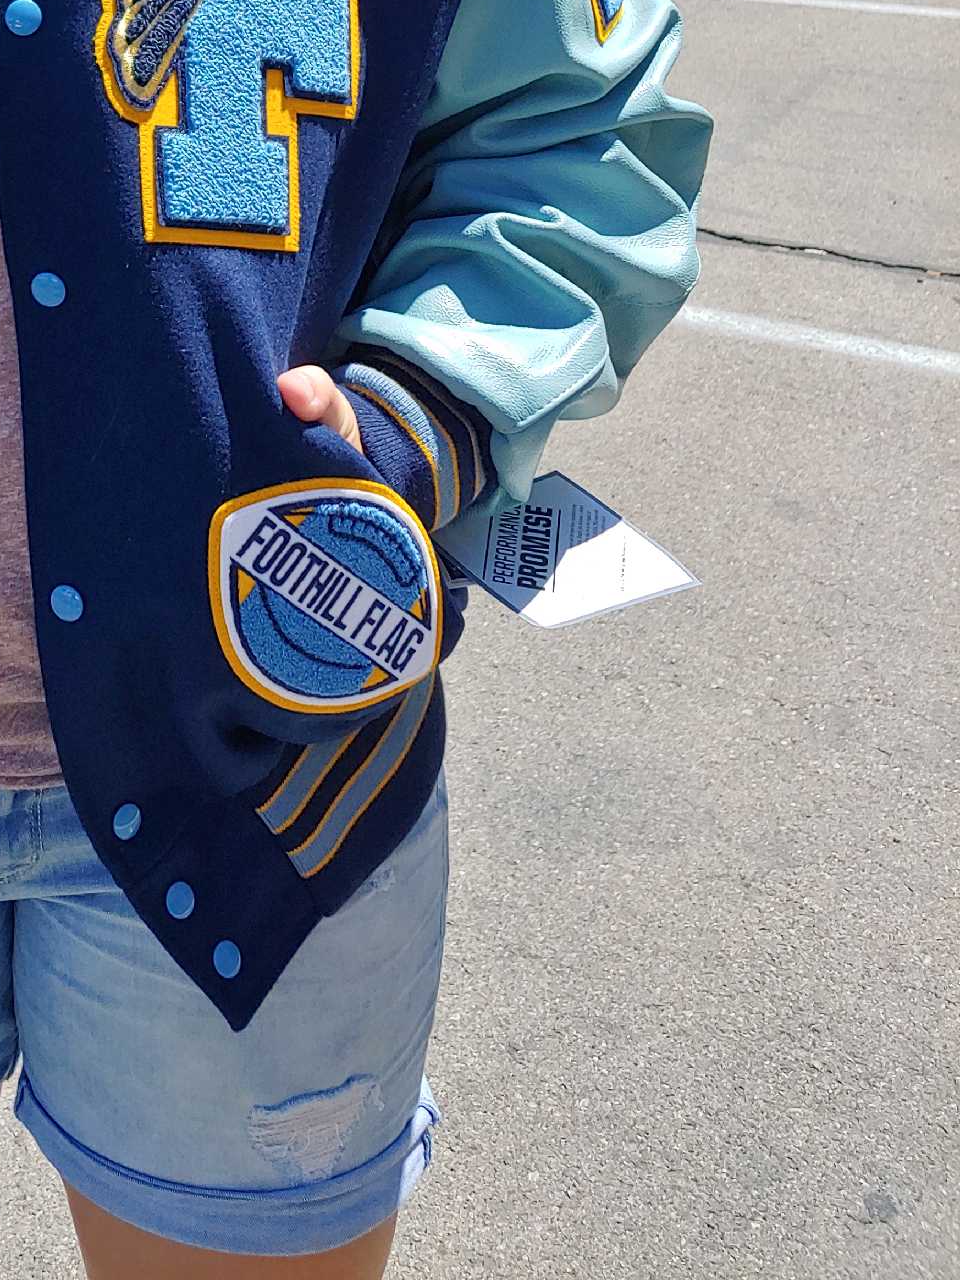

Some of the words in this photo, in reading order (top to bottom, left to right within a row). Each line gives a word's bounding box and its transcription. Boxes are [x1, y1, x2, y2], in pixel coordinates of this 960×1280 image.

[237, 516, 363, 631] FOOTHILL
[350, 598, 425, 673] FLAG
[517, 504, 553, 591] PROMISE
